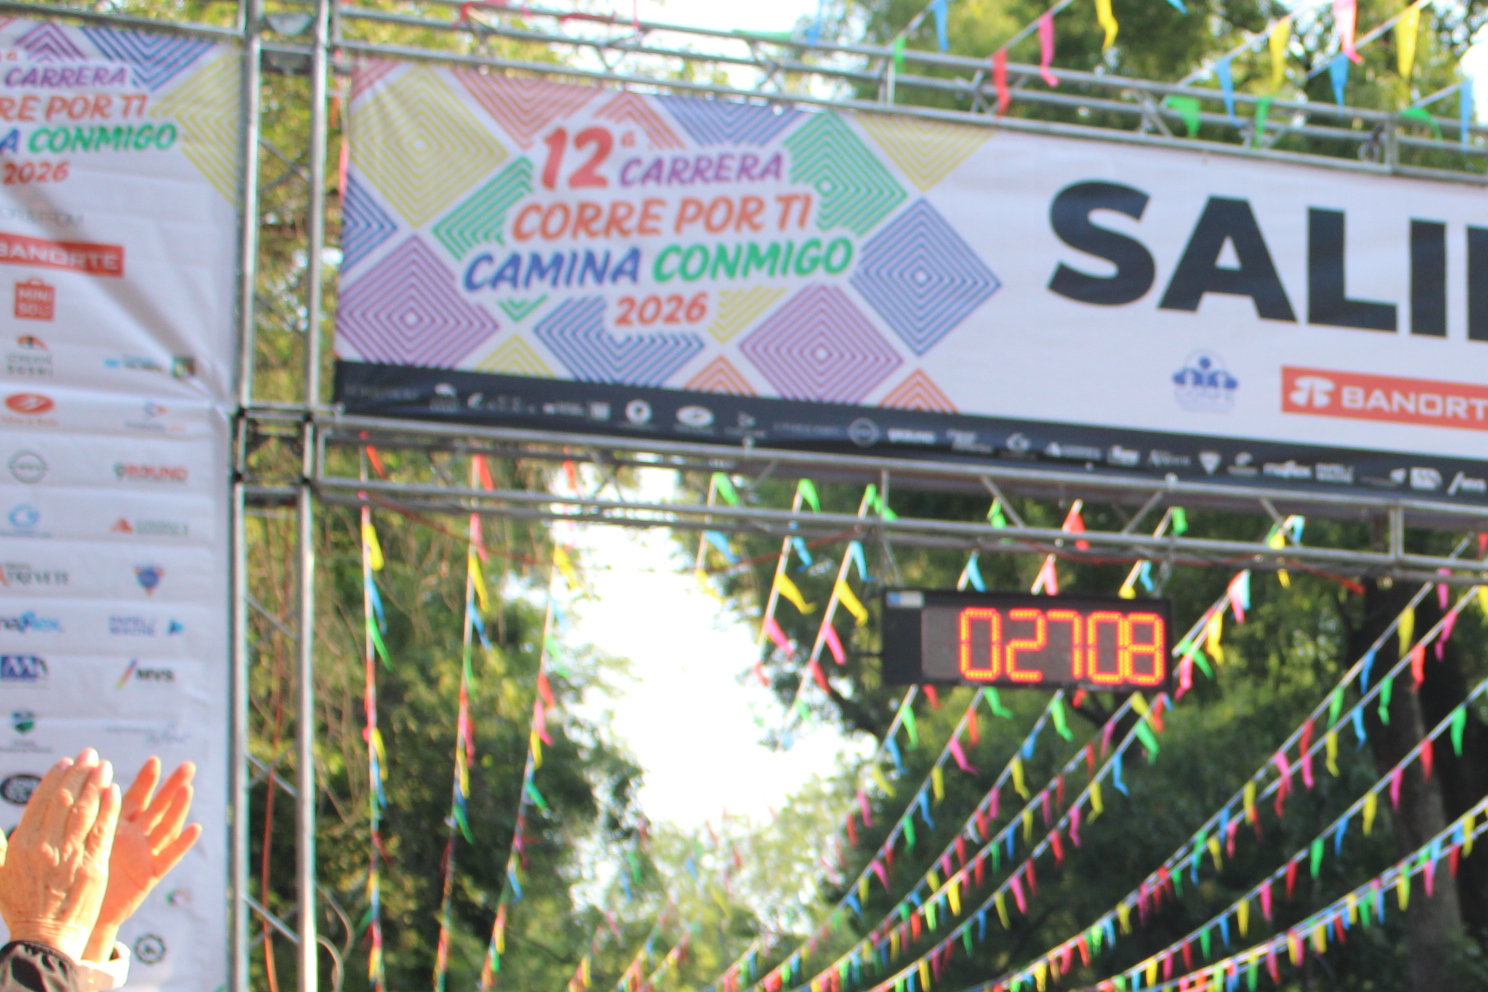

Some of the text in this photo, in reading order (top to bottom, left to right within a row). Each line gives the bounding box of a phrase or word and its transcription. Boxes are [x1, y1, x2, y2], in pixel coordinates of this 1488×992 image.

[5, 66, 127, 89] CARRERA
[45, 94, 113, 122] POR
[120, 94, 148, 119] TI
[28, 122, 178, 154] CONMIGO
[3, 160, 69, 186] 2026
[619, 151, 784, 188] CARRERA
[511, 193, 813, 242] CORRE POR TI
[462, 237, 855, 292] CAMINA CONMIGO
[614, 293, 708, 328] 2026
